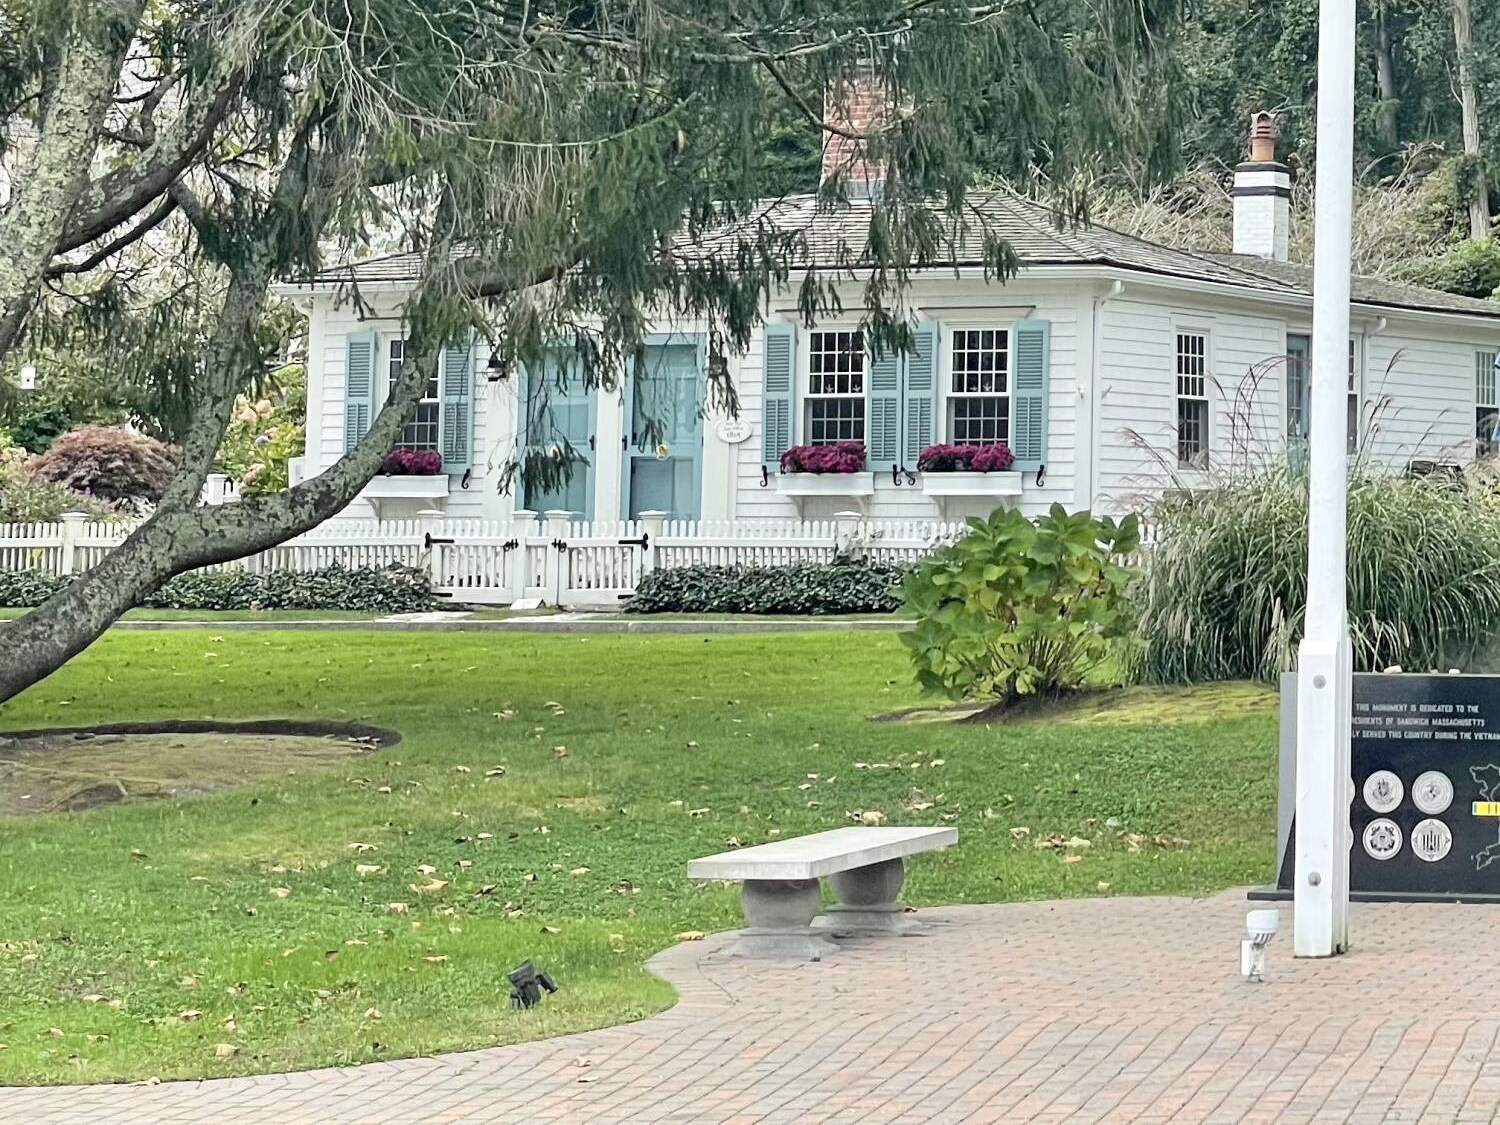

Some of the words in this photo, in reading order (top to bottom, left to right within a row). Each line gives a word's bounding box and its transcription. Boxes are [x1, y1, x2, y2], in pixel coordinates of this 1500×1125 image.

[1355, 703, 1370, 712] THIS
[1372, 703, 1408, 712] MONUMENT
[1410, 704, 1417, 712] IS
[1419, 704, 1454, 713] DEDICATED
[1456, 705, 1465, 713] TO
[1467, 705, 1480, 713] THE
[1351, 716, 1383, 725] ESIDENTS
[1385, 717, 1394, 725] OF
[1397, 717, 1429, 726] SANDWICH
[1431, 718, 1485, 727] MASSACHUSETTS
[1362, 730, 1386, 738] SERVED
[1388, 731, 1402, 739] THIS
[1403, 731, 1433, 739] COUNTRY
[1434, 731, 1458, 739] DURING
[1459, 732, 1472, 740] THE
